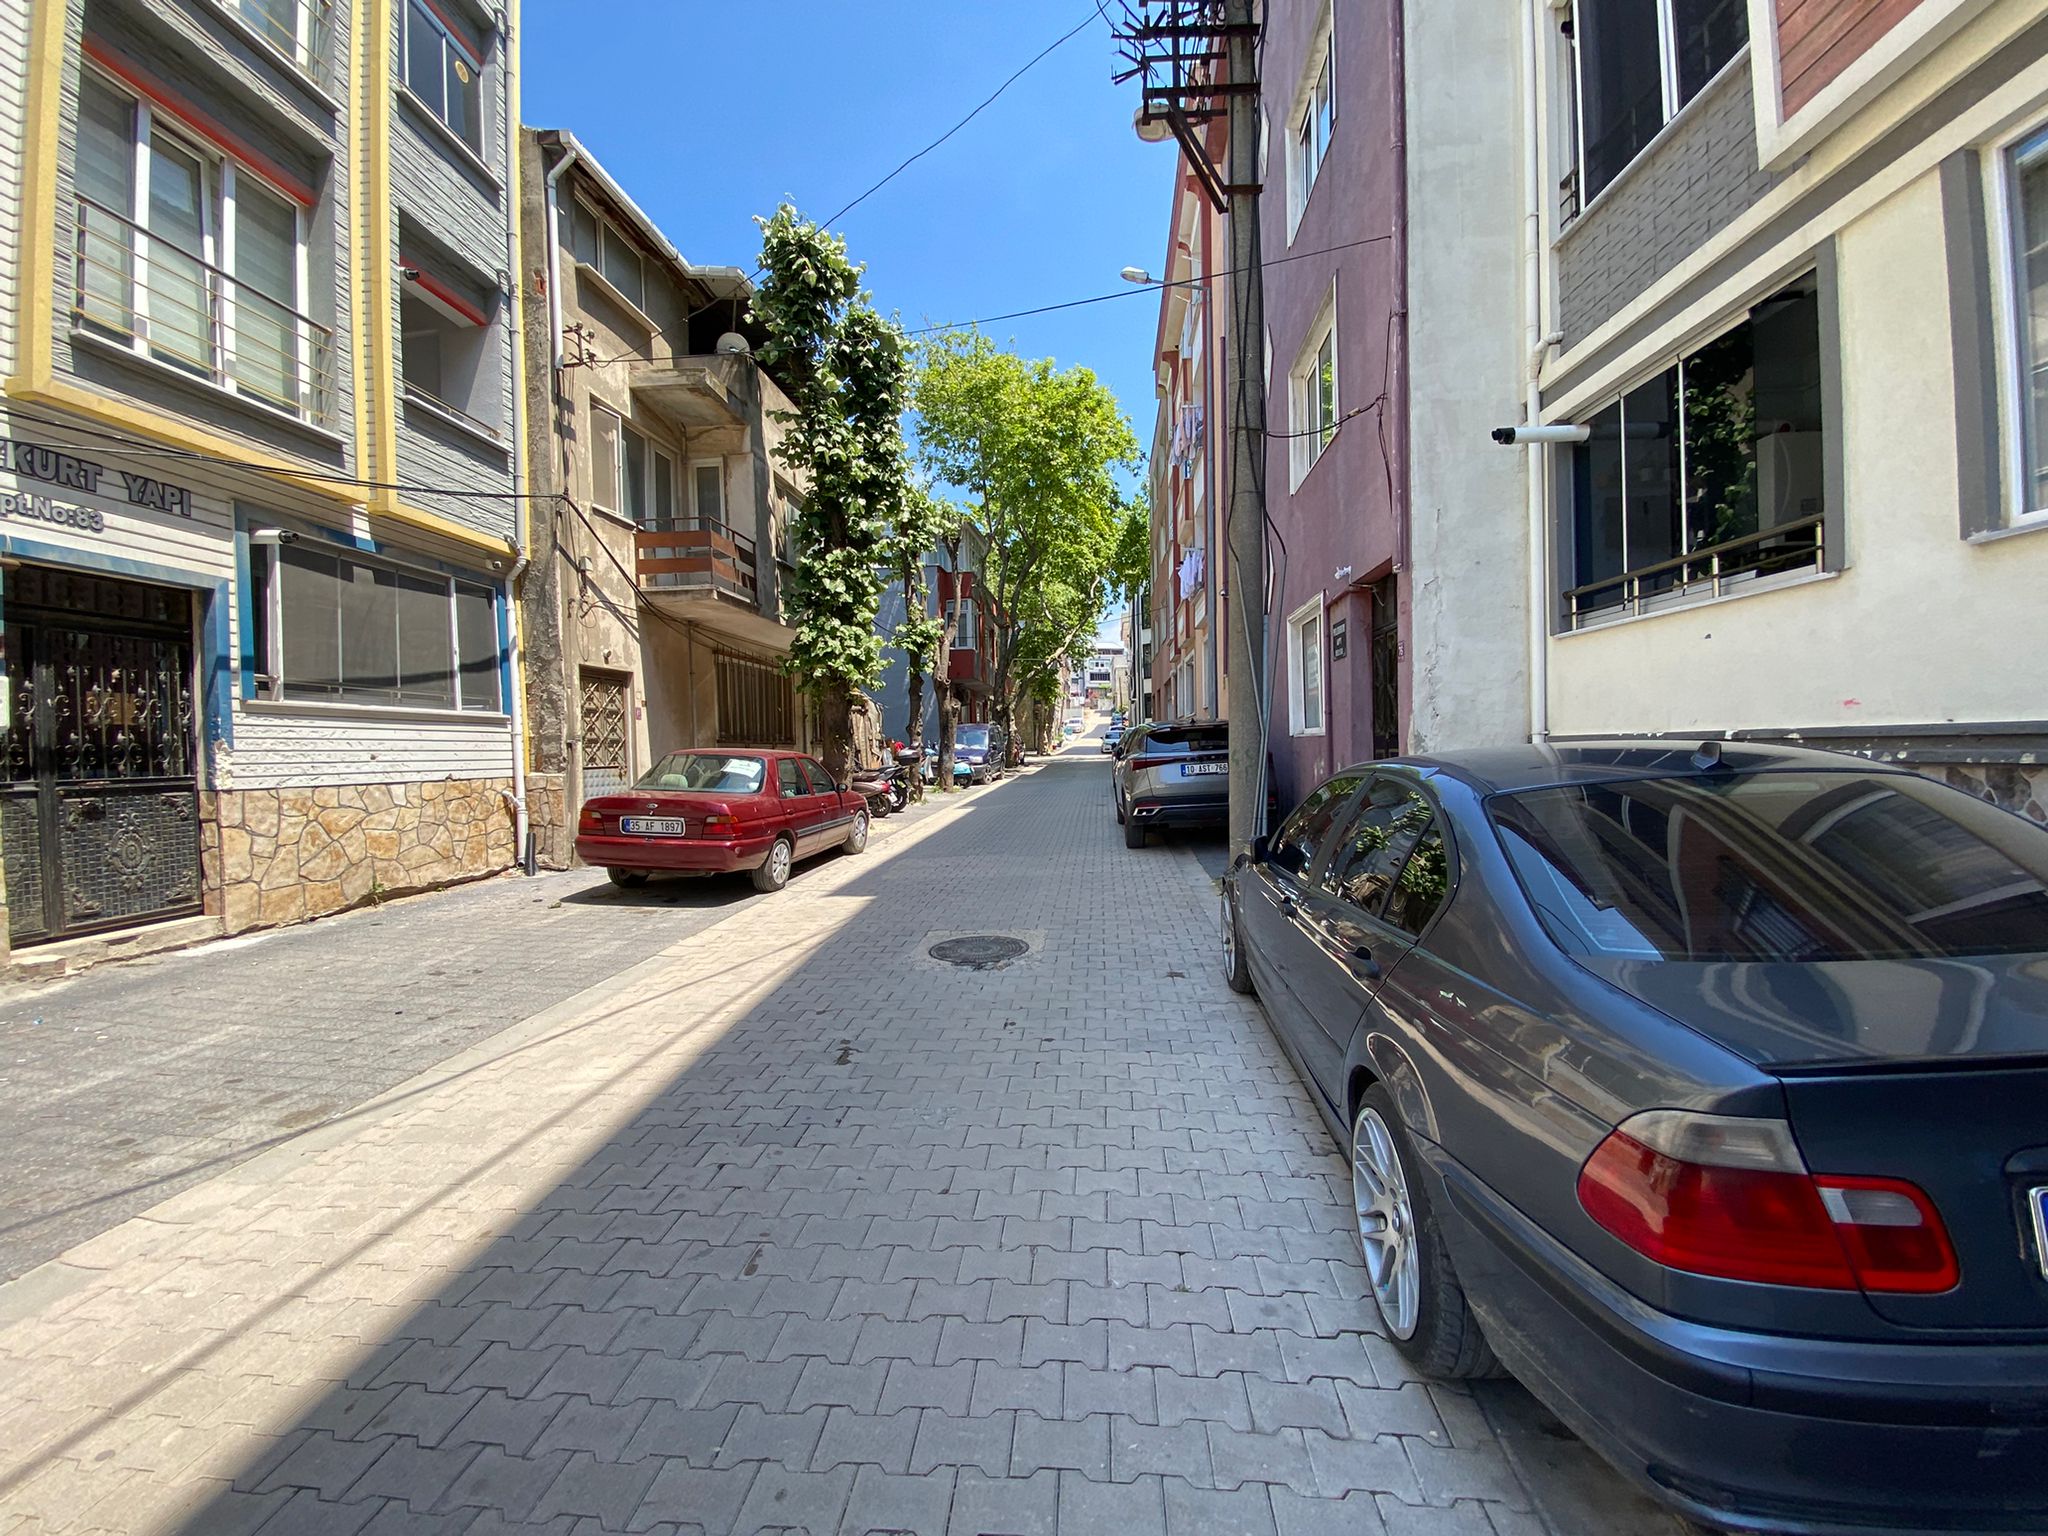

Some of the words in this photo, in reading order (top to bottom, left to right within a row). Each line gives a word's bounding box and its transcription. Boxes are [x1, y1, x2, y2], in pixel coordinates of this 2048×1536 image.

[121, 472, 192, 516] YAPI
[1199, 764, 1211, 772] AST
[630, 820, 641, 831] 35
[645, 821, 655, 831] AF
[661, 822, 680, 832] 1897
